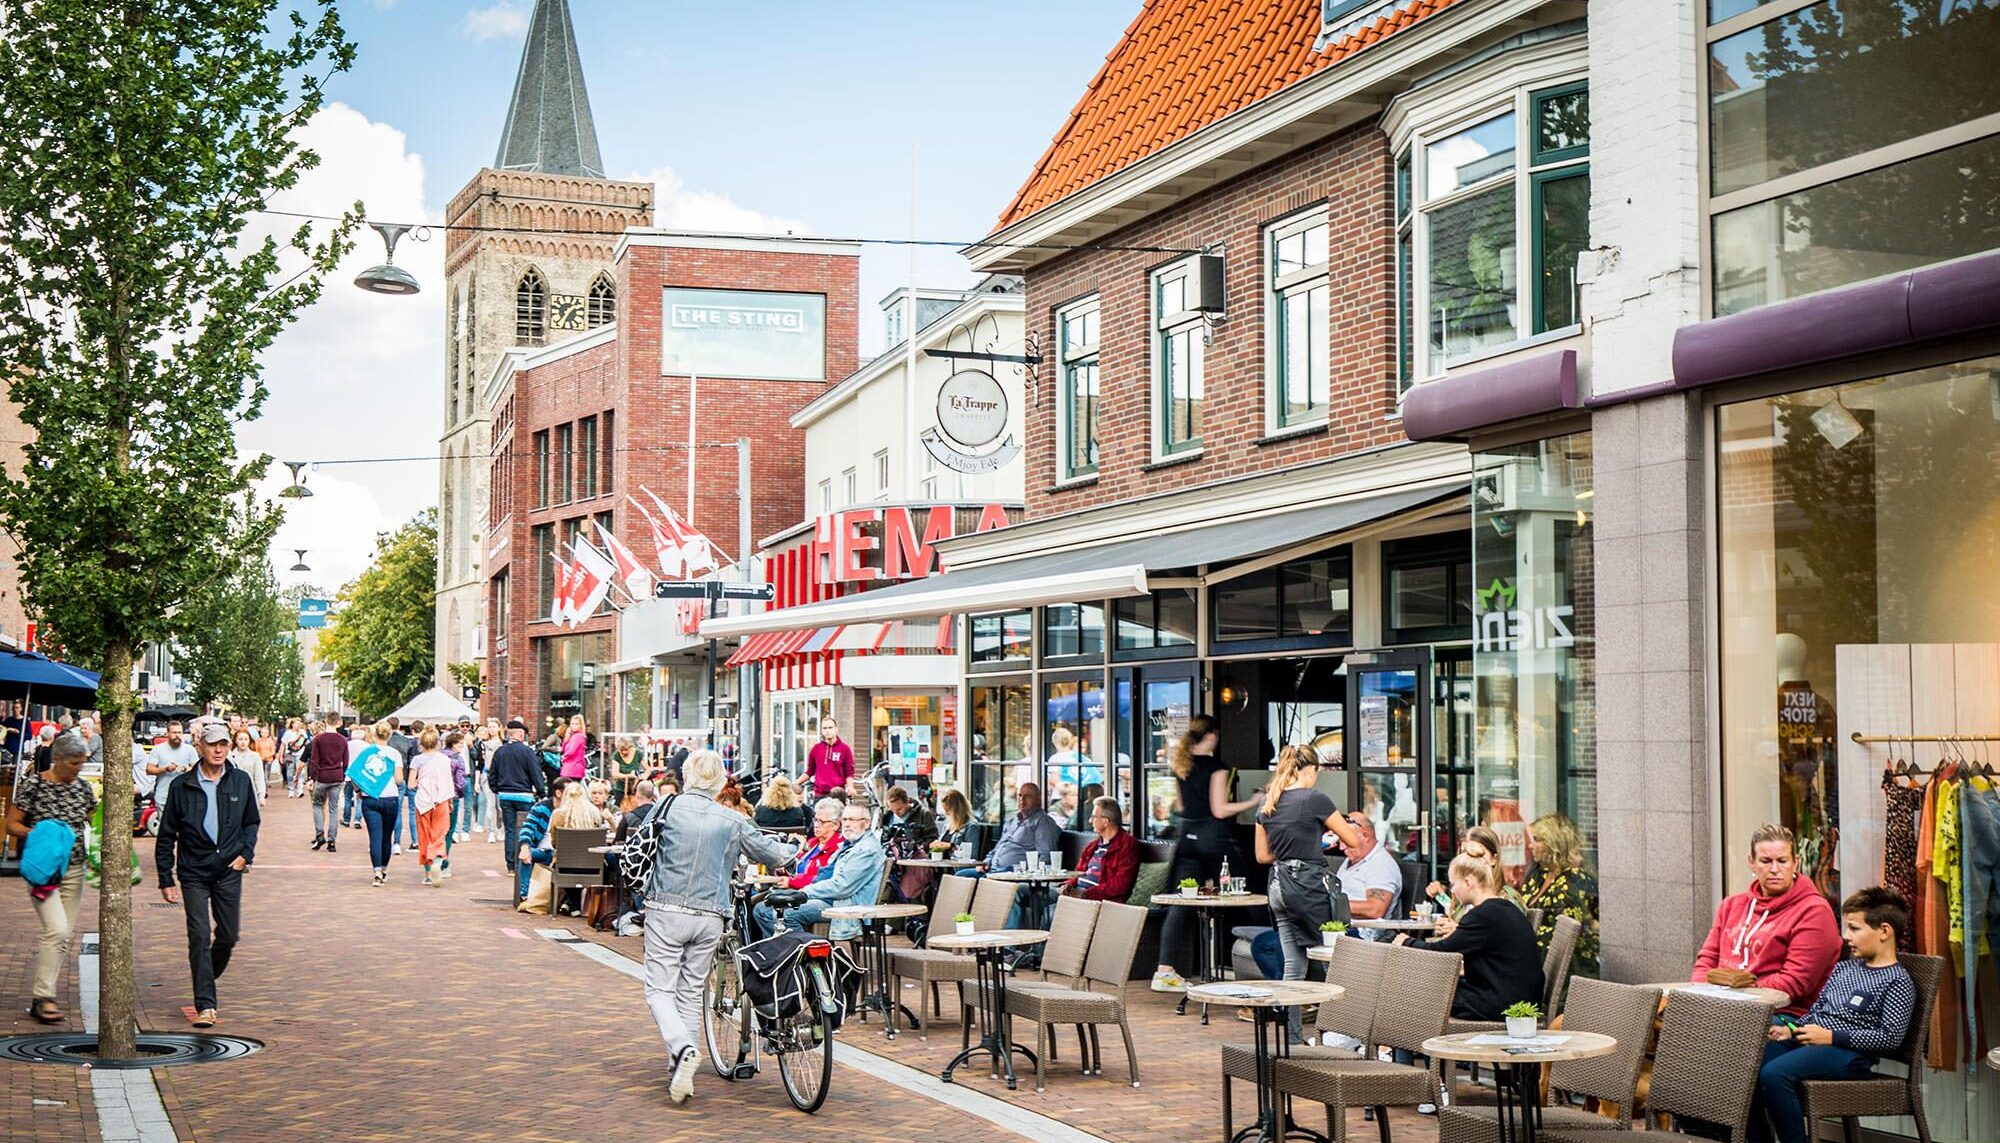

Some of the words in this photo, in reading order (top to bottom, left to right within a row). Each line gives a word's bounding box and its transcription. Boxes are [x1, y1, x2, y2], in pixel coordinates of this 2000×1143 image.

[677, 308, 720, 324] THE
[727, 311, 798, 328] STING
[962, 395, 998, 412] Trappe
[832, 751, 841, 762] H
